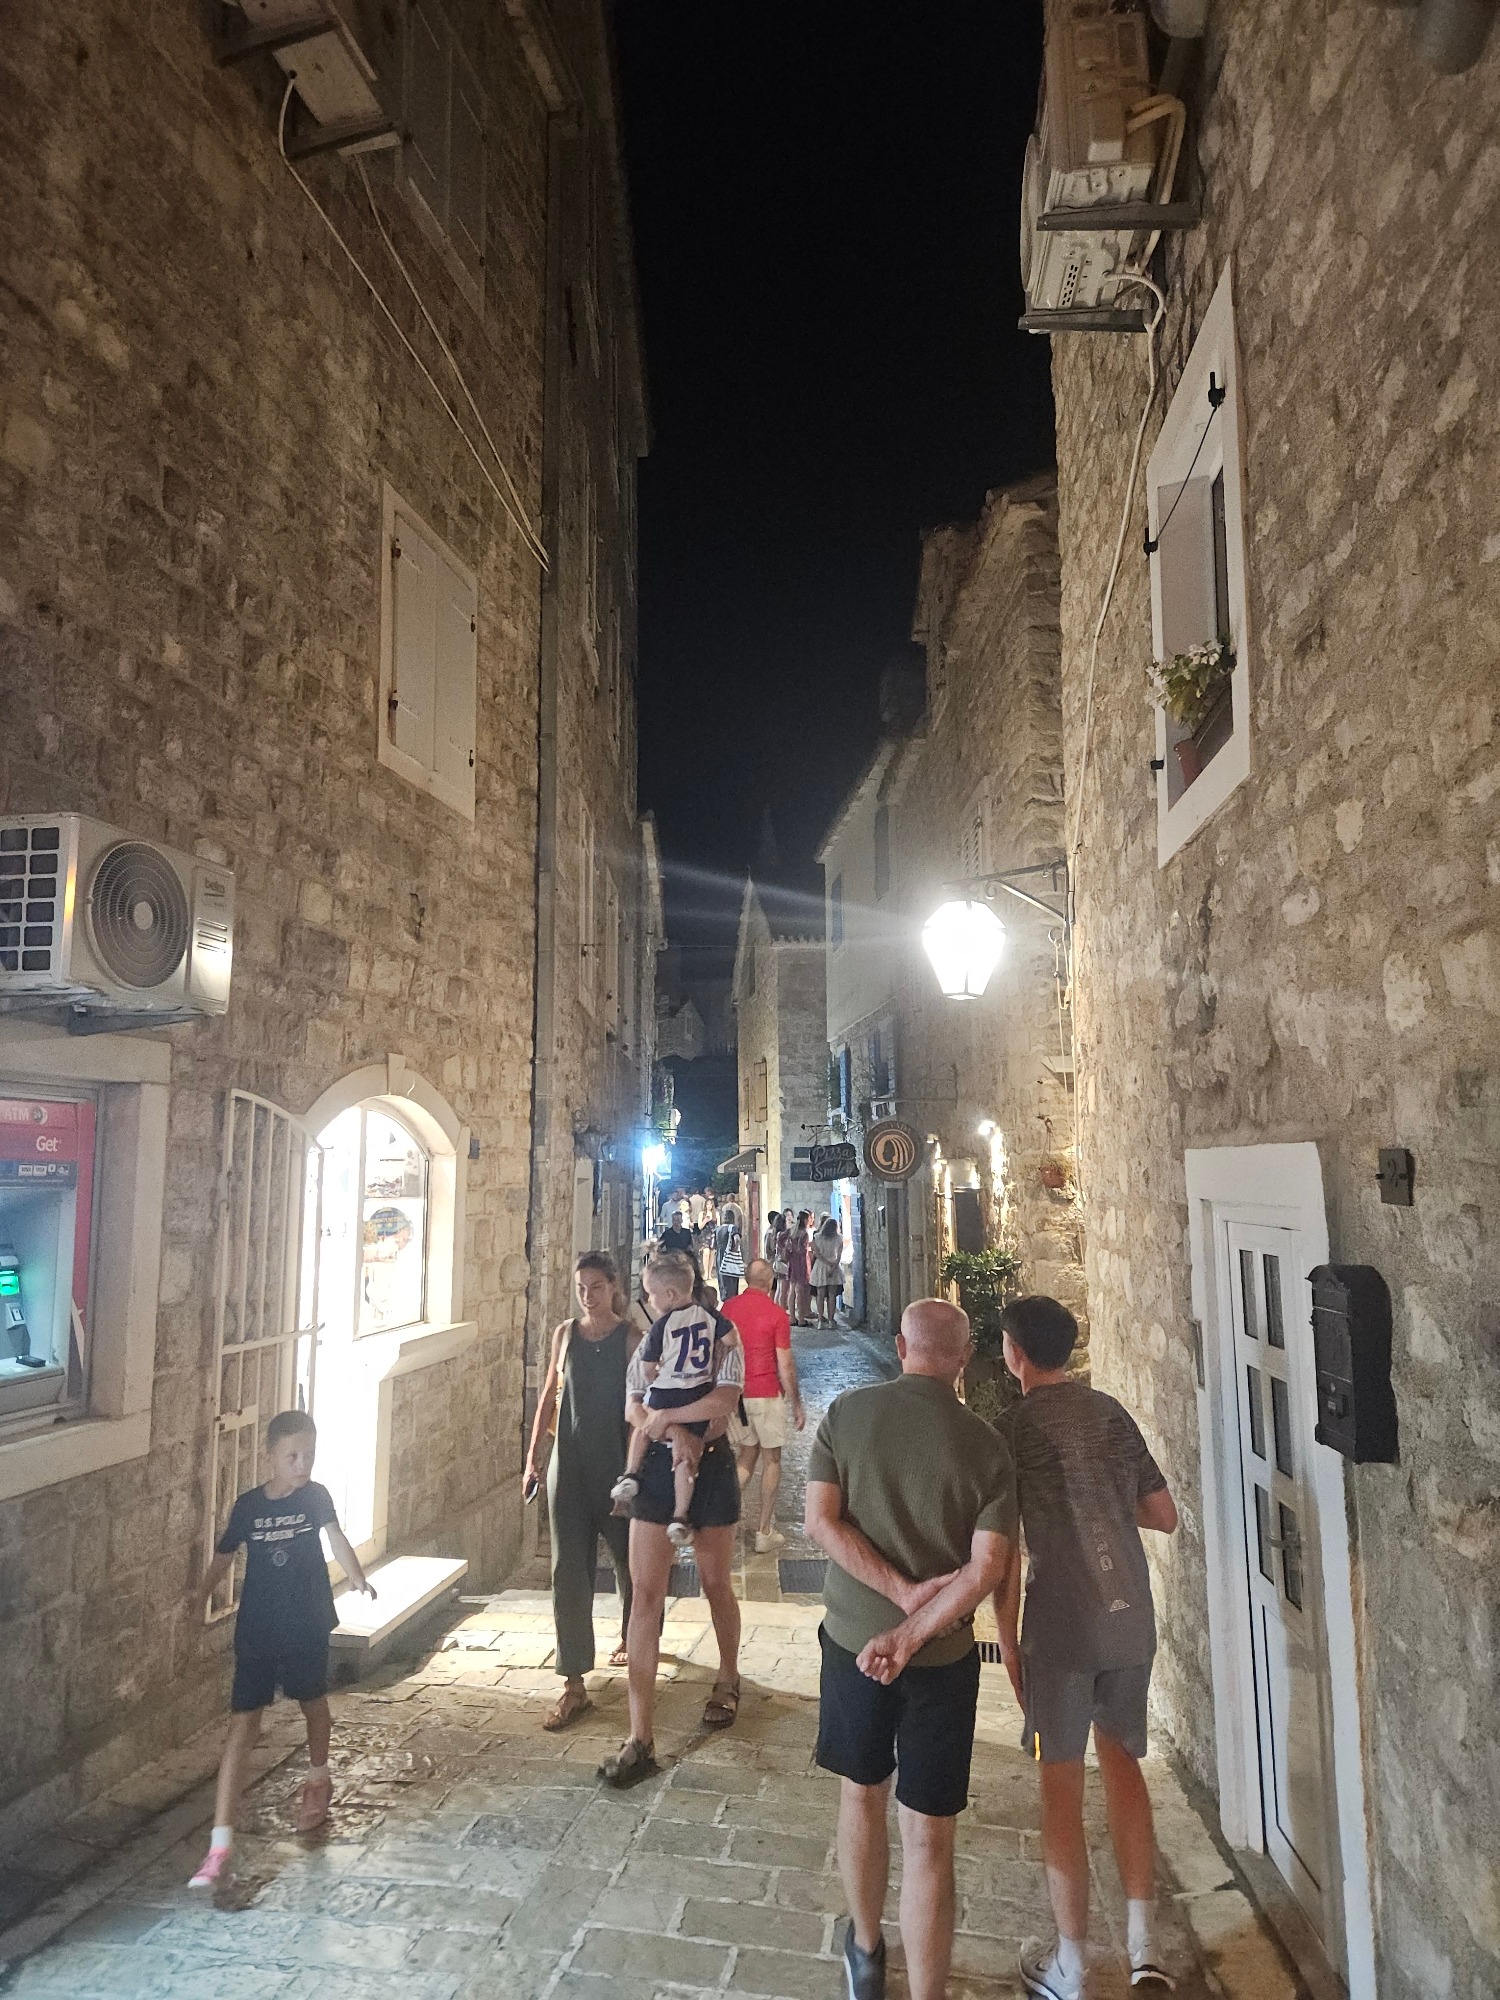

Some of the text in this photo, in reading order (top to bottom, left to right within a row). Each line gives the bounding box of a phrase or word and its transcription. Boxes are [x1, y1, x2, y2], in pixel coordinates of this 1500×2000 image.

[3, 1107, 29, 1121] ATM
[36, 1135, 59, 1152] Get
[812, 1146, 854, 1164] Pizza
[813, 1161, 853, 1181] Smiley
[671, 1321, 711, 1372] 75
[275, 1513, 306, 1527] POLO
